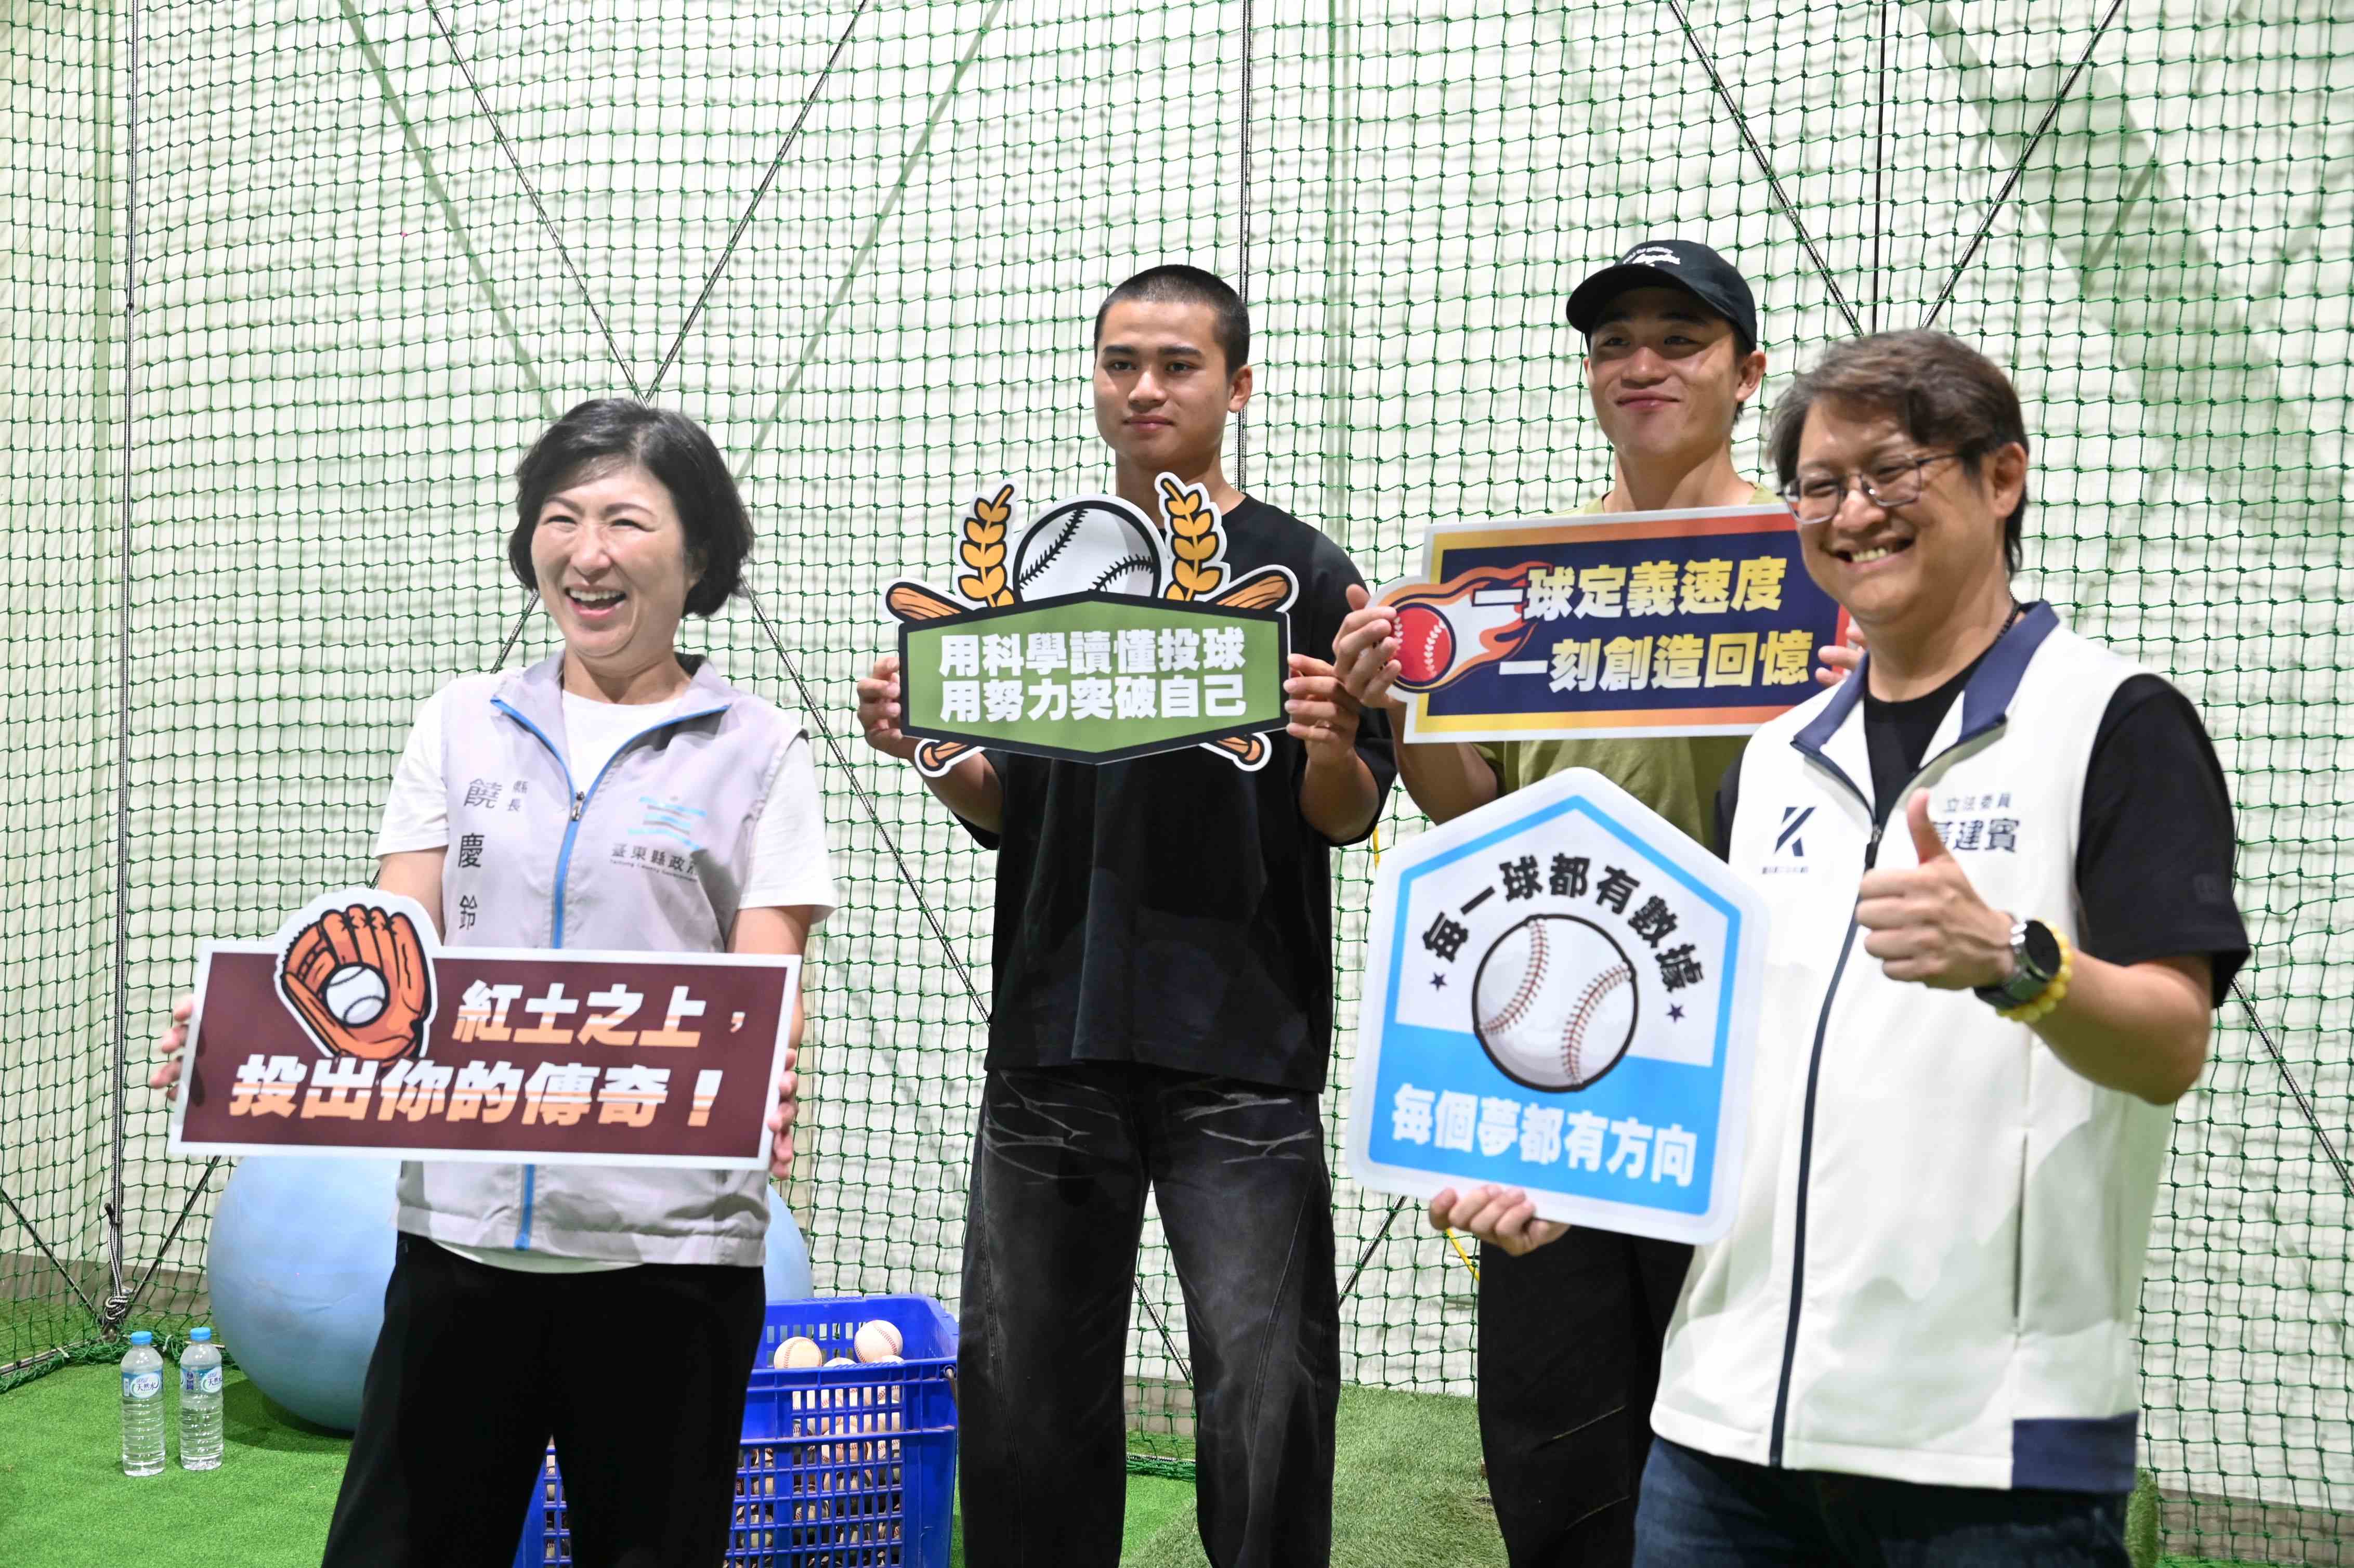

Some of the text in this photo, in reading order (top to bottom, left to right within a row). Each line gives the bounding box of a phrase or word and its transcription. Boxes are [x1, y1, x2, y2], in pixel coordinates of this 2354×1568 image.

[1473, 556, 1787, 623] 一球定義速度
[939, 626, 1246, 677] 用科學讀懂投球
[1498, 630, 1814, 694] 一刻創造回憶
[940, 674, 1246, 723] 用努力突破自己
[1422, 852, 1704, 992] 每一球都有數據
[1391, 1083, 1698, 1186] 每個夢都有方向
